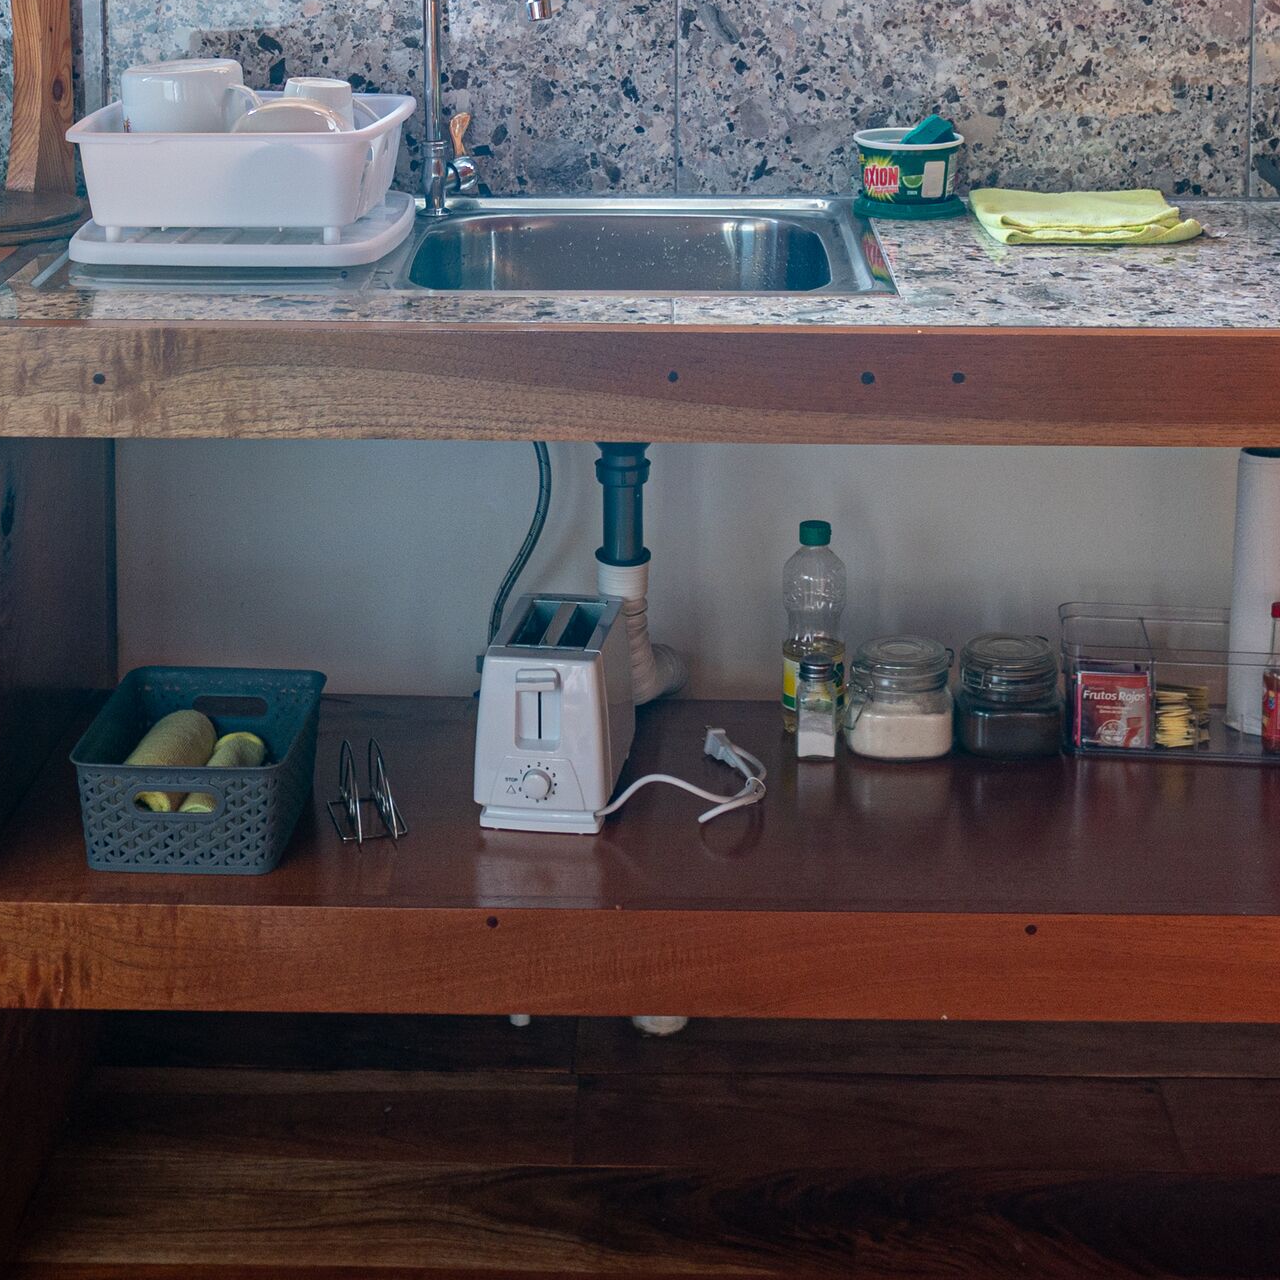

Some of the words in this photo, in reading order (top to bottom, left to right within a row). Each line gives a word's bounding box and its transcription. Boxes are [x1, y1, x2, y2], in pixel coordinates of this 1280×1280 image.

[864, 165, 899, 190] AXION
[1083, 690, 1117, 701] Frutos
[1118, 691, 1145, 703] Rojos
